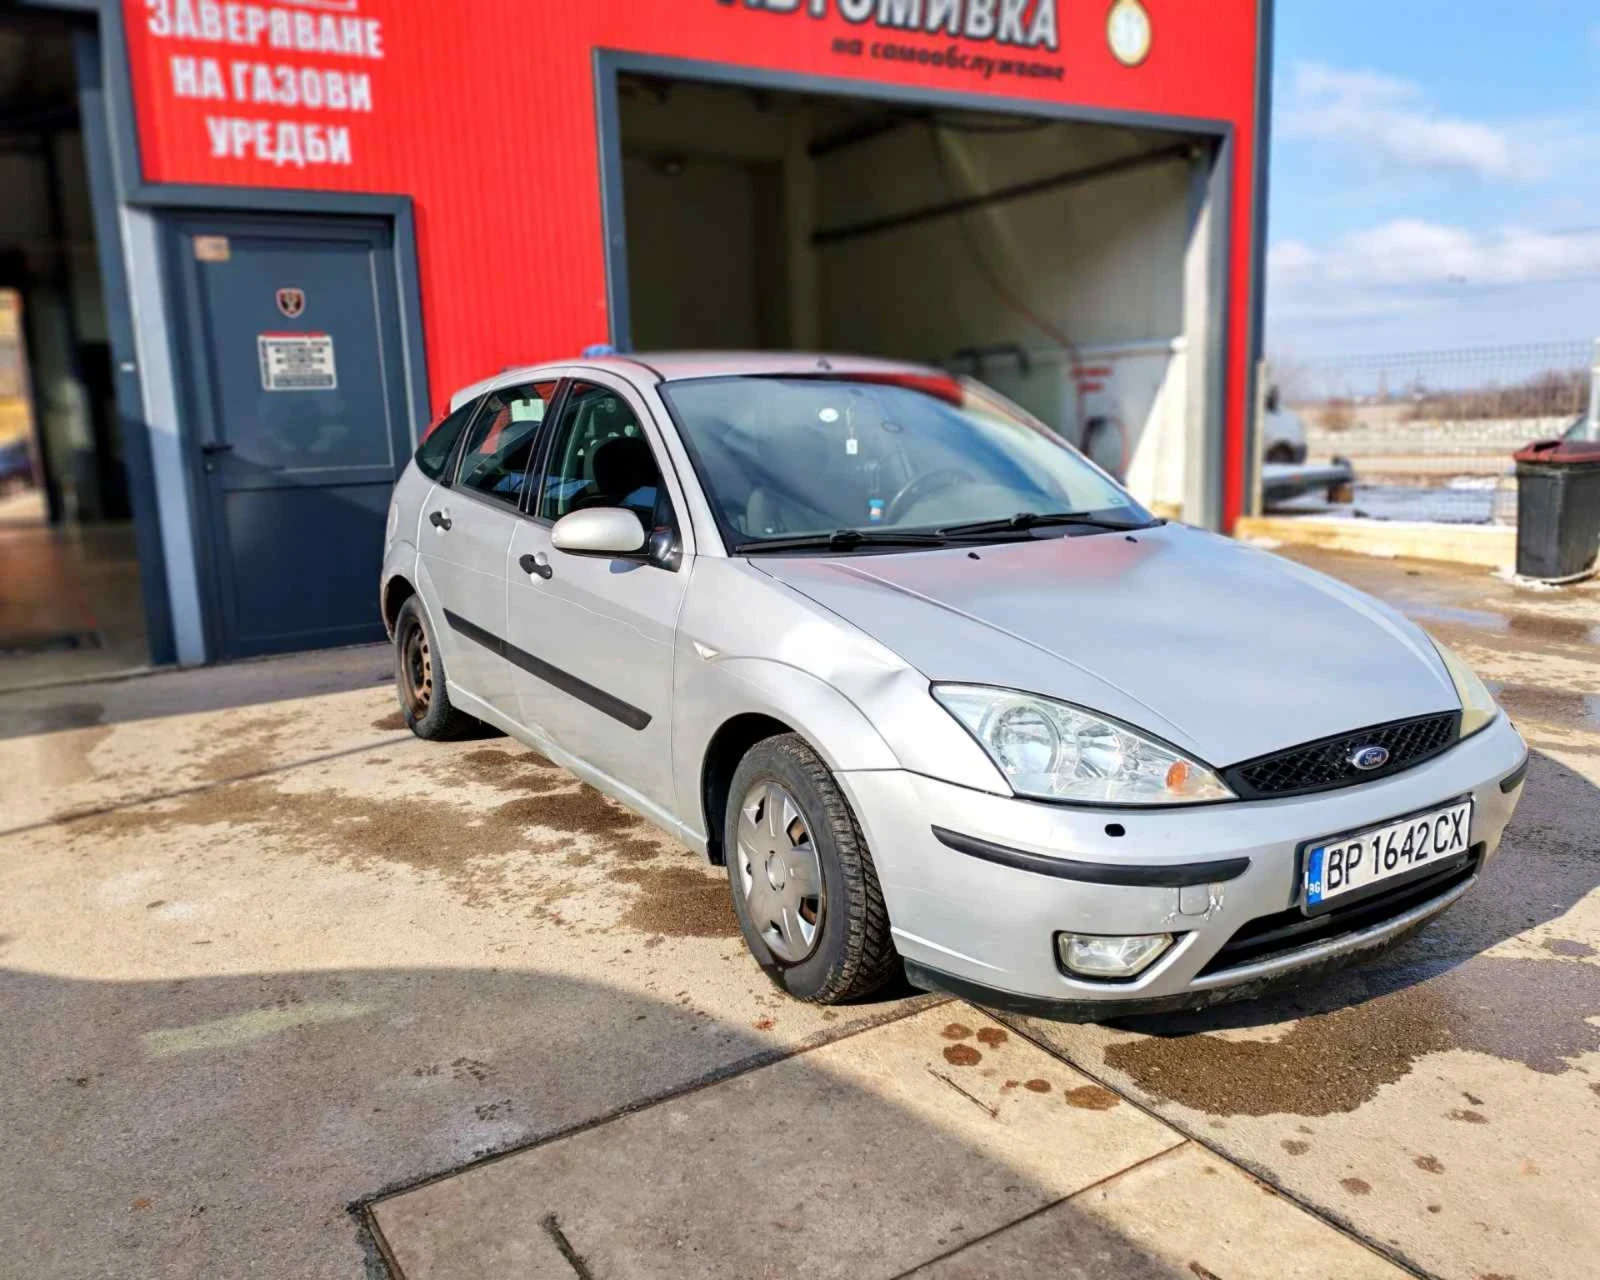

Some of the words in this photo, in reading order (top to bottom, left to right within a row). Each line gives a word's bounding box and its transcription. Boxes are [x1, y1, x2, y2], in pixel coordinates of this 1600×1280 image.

[147, 0, 384, 58] ЗАВЕРЯВАНЕ
[171, 55, 225, 99] НА
[231, 61, 373, 112] ГАЗОВИ
[205, 116, 352, 167] УРЕДБИ
[1327, 842, 1363, 890] BP
[1371, 822, 1429, 875] 1642
[1433, 809, 1465, 854] CX
[1308, 881, 1321, 896] BG
